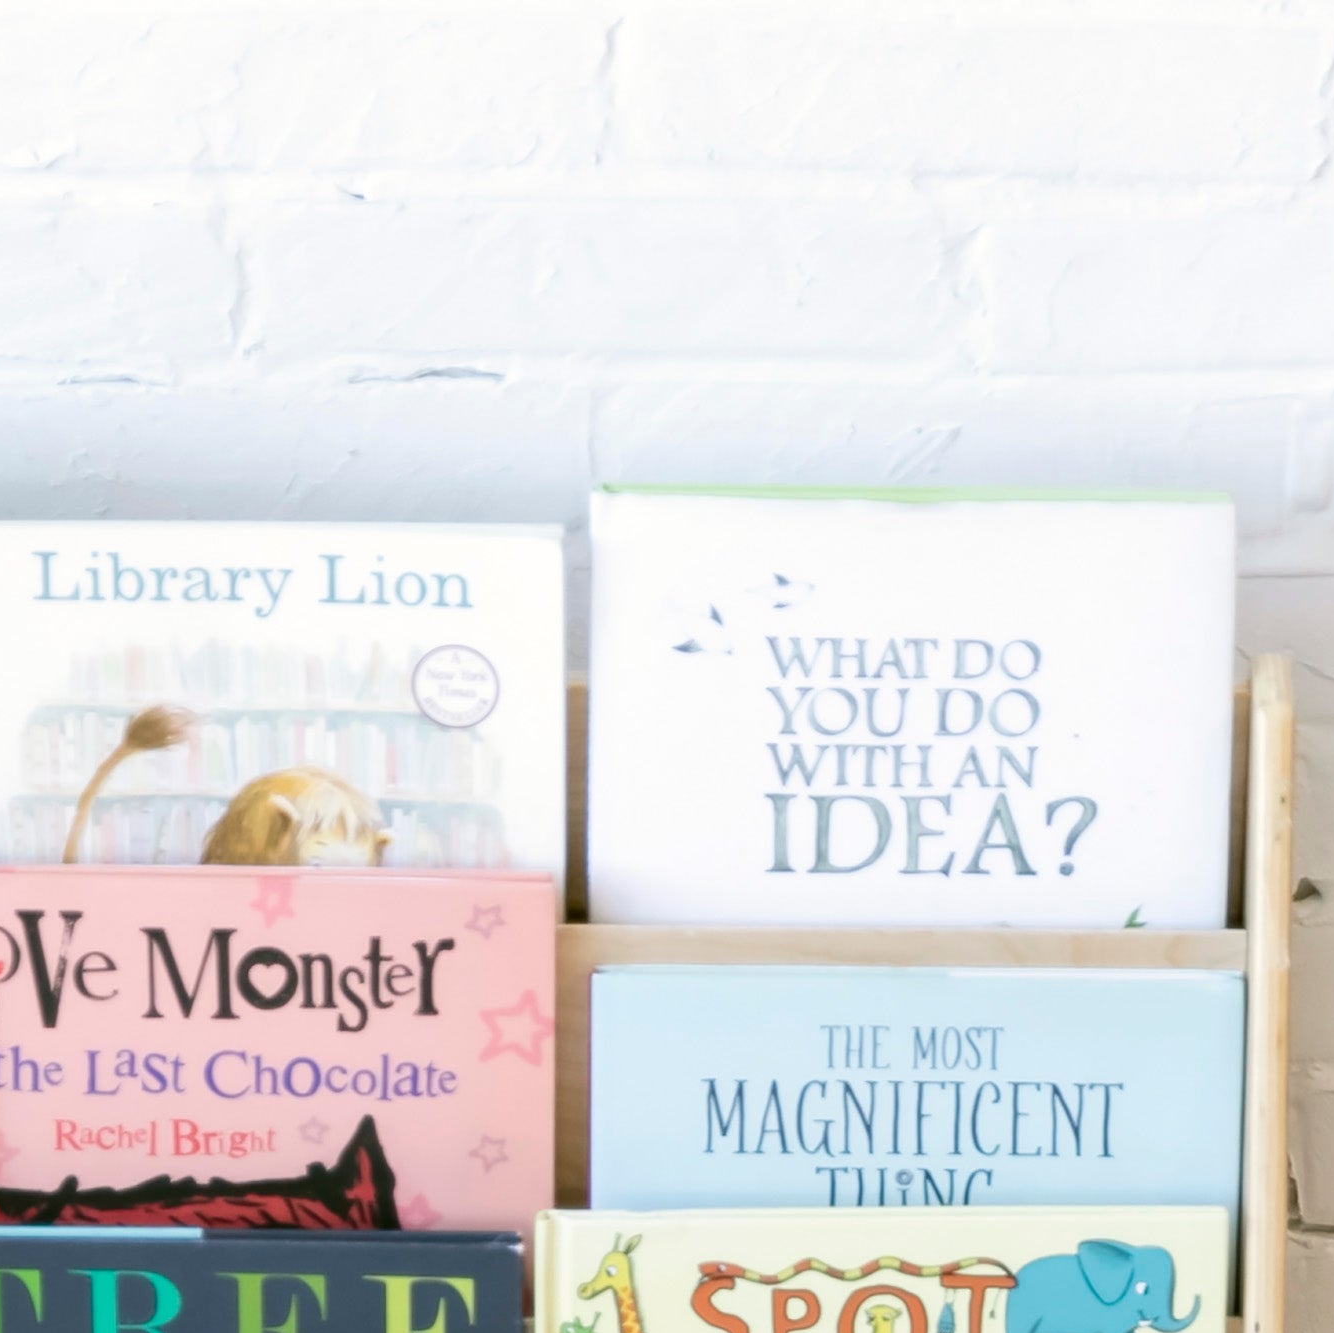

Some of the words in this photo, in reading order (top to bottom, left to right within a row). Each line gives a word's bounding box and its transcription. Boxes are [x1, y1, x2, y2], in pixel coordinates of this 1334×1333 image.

[32, 549, 294, 618] Library
[319, 554, 475, 609] Lion
[766, 637, 937, 680] WHAT
[953, 640, 1043, 681] DO
[766, 686, 911, 738] YOU
[933, 687, 1041, 738] DO
[765, 743, 933, 787] WITH
[953, 746, 1040, 788] AN
[763, 793, 1099, 877] IDEA?
[141, 926, 456, 1033] Monster
[820, 1025, 891, 1069] THE
[912, 1026, 1005, 1071] MOST
[54, 1119, 158, 1157] Rachel
[171, 1119, 276, 1158] Bright
[701, 1078, 1124, 1159] MAGNIFICENT
